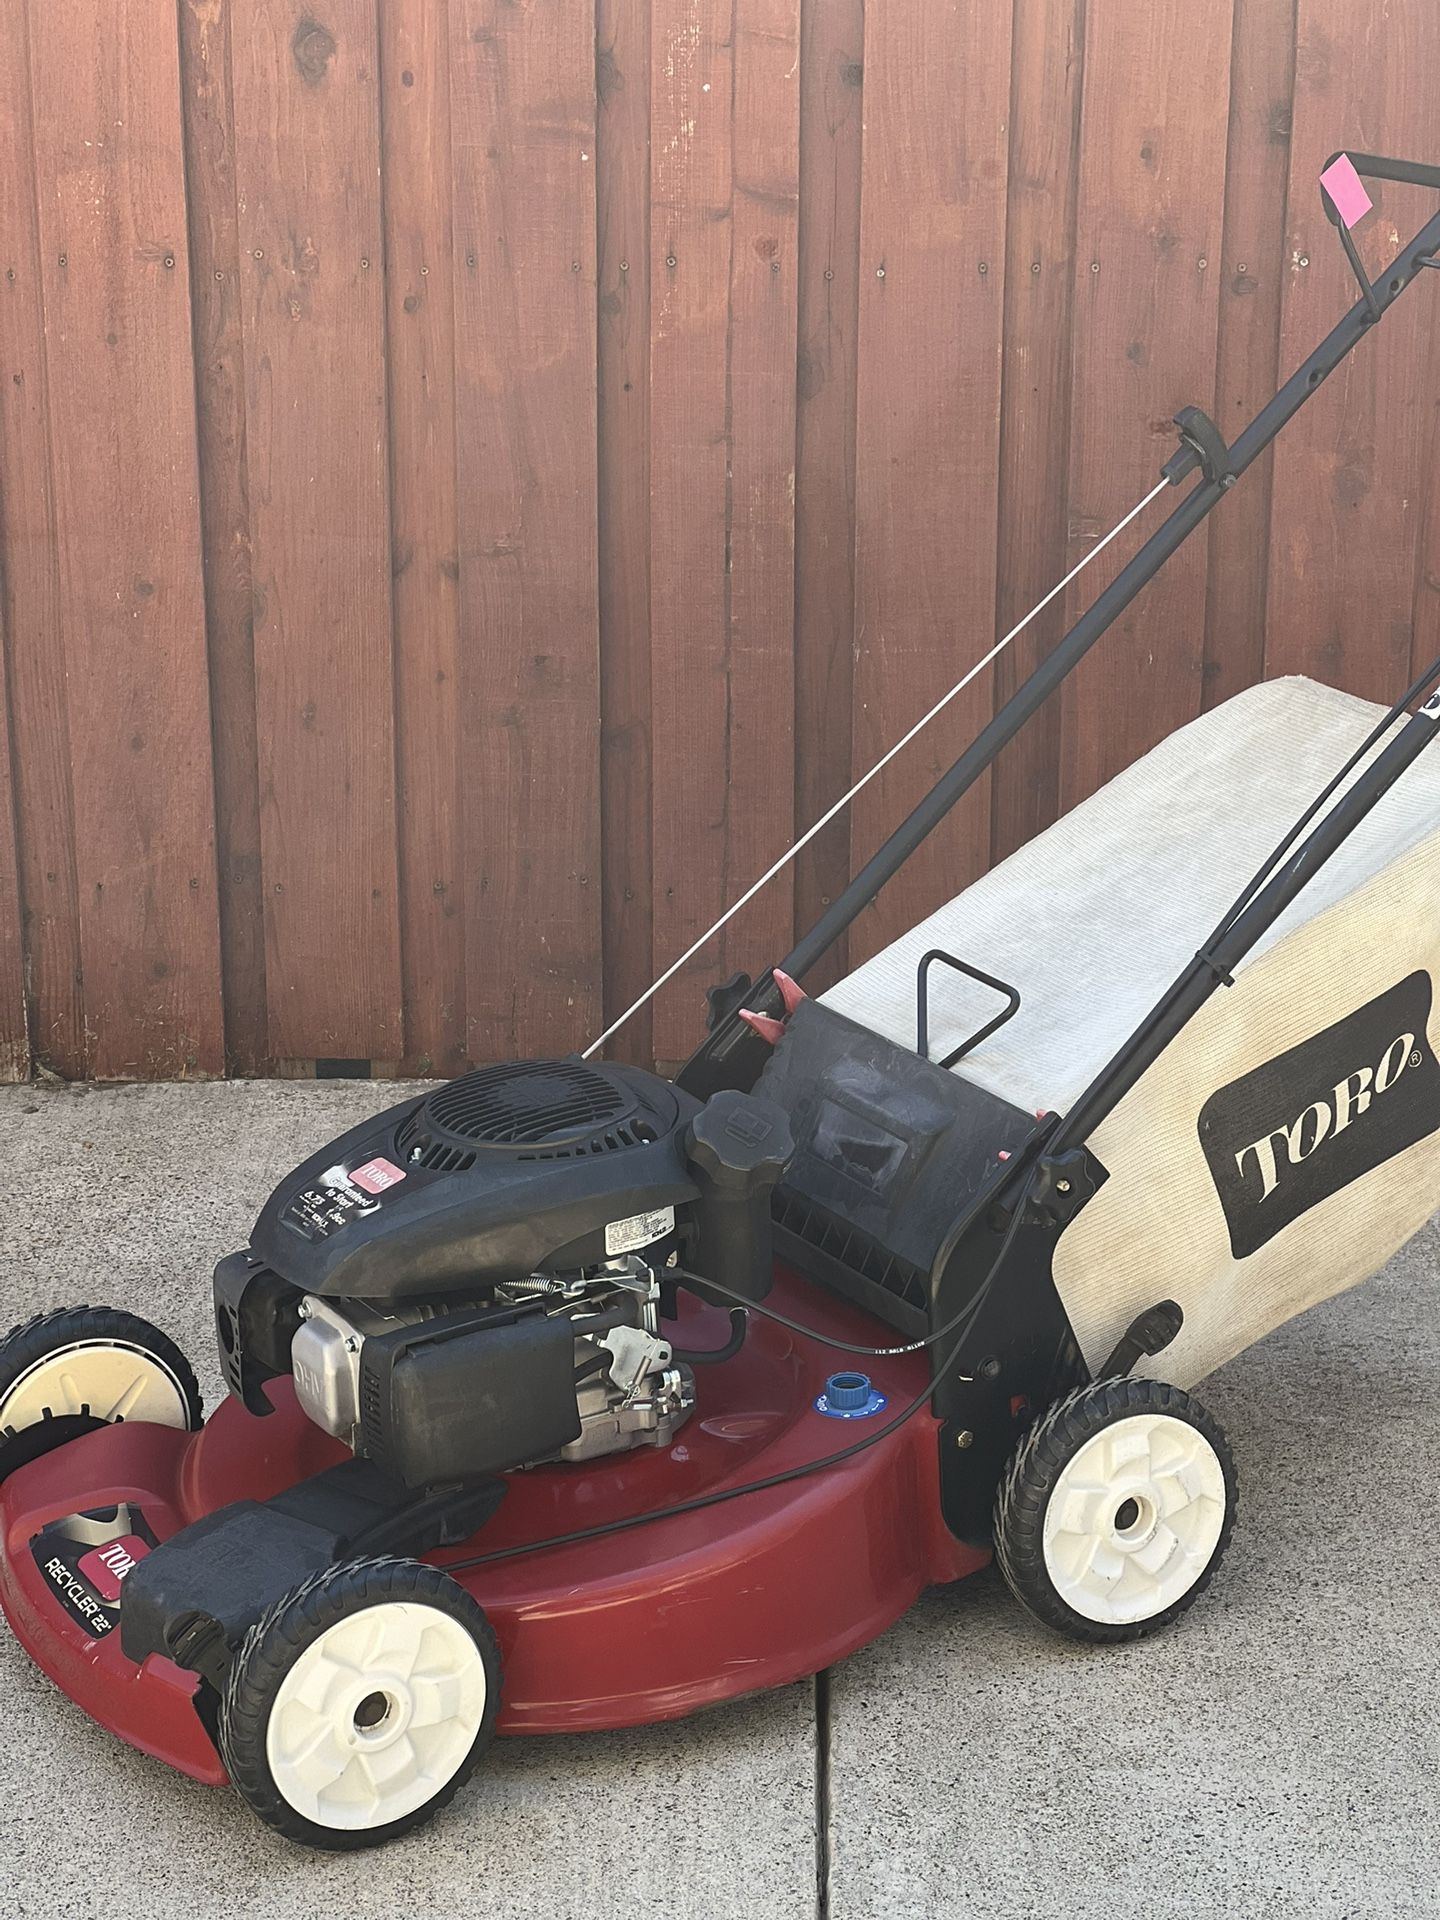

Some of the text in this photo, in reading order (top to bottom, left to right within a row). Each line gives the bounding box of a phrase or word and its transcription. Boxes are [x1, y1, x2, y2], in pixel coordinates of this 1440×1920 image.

[360, 1164, 394, 1187] TORO
[328, 1177, 374, 1207] Guaranteed
[332, 1193, 355, 1209] Start
[98, 1543, 137, 1581] TOR
[44, 1557, 101, 1618] RECYCLER
